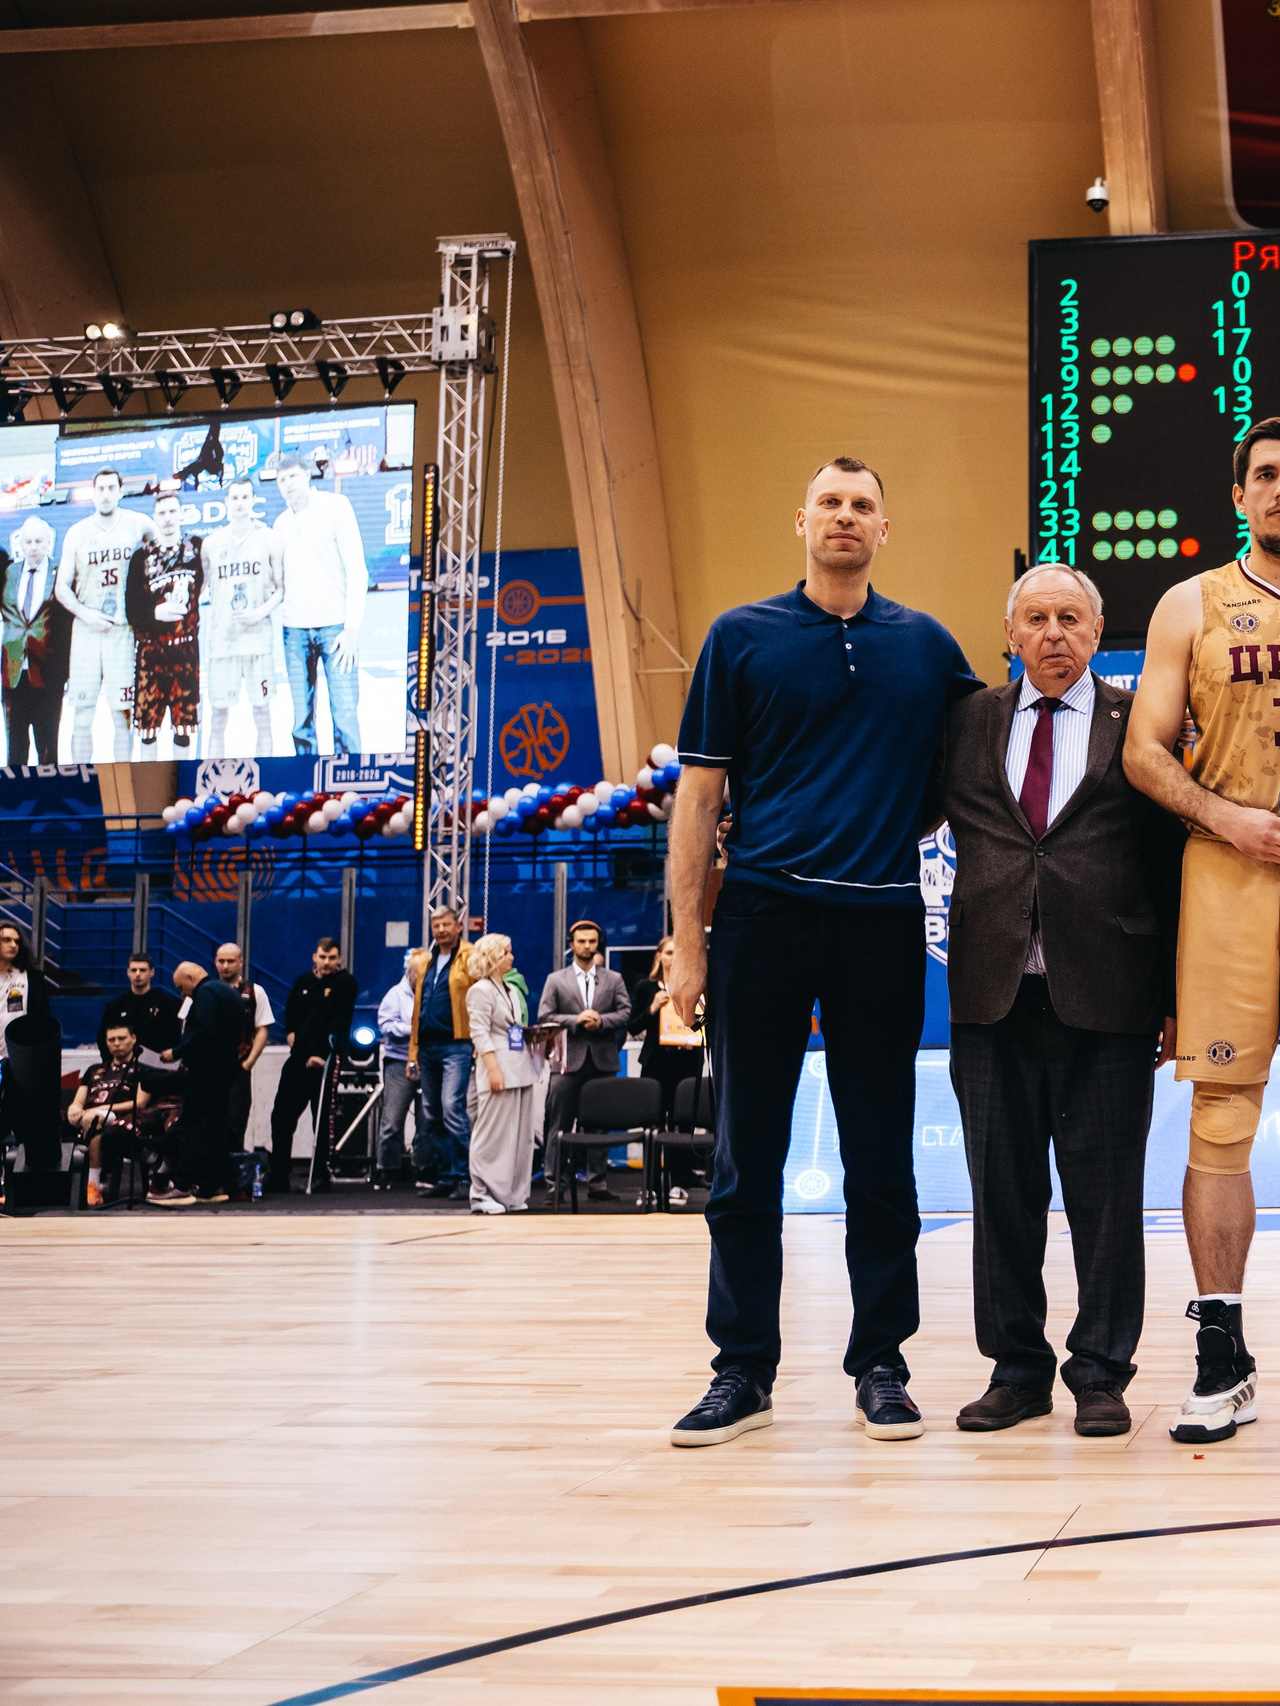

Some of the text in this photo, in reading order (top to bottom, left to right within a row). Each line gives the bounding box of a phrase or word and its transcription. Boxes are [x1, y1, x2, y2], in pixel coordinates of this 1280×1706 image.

[1059, 278, 1079, 307] 2
[1231, 270, 1251, 299] 0
[1059, 307, 1079, 335] 3
[1211, 299, 1246, 328] 11
[1060, 335, 1079, 363] 5
[1212, 327, 1252, 356] 17
[1060, 364, 1080, 392] 9
[1232, 356, 1252, 384] 0
[1041, 392, 1080, 421] 12
[1213, 384, 1253, 414] 13
[1041, 421, 1080, 450] 13
[1041, 450, 1082, 479] 14
[1038, 479, 1075, 509] 21
[1038, 508, 1081, 538] 33
[88, 547, 132, 566] ЦИВС
[1038, 537, 1076, 566] 41
[101, 568, 119, 587] 35
[218, 561, 261, 580] ЦИВС
[485, 628, 567, 647] 2016
